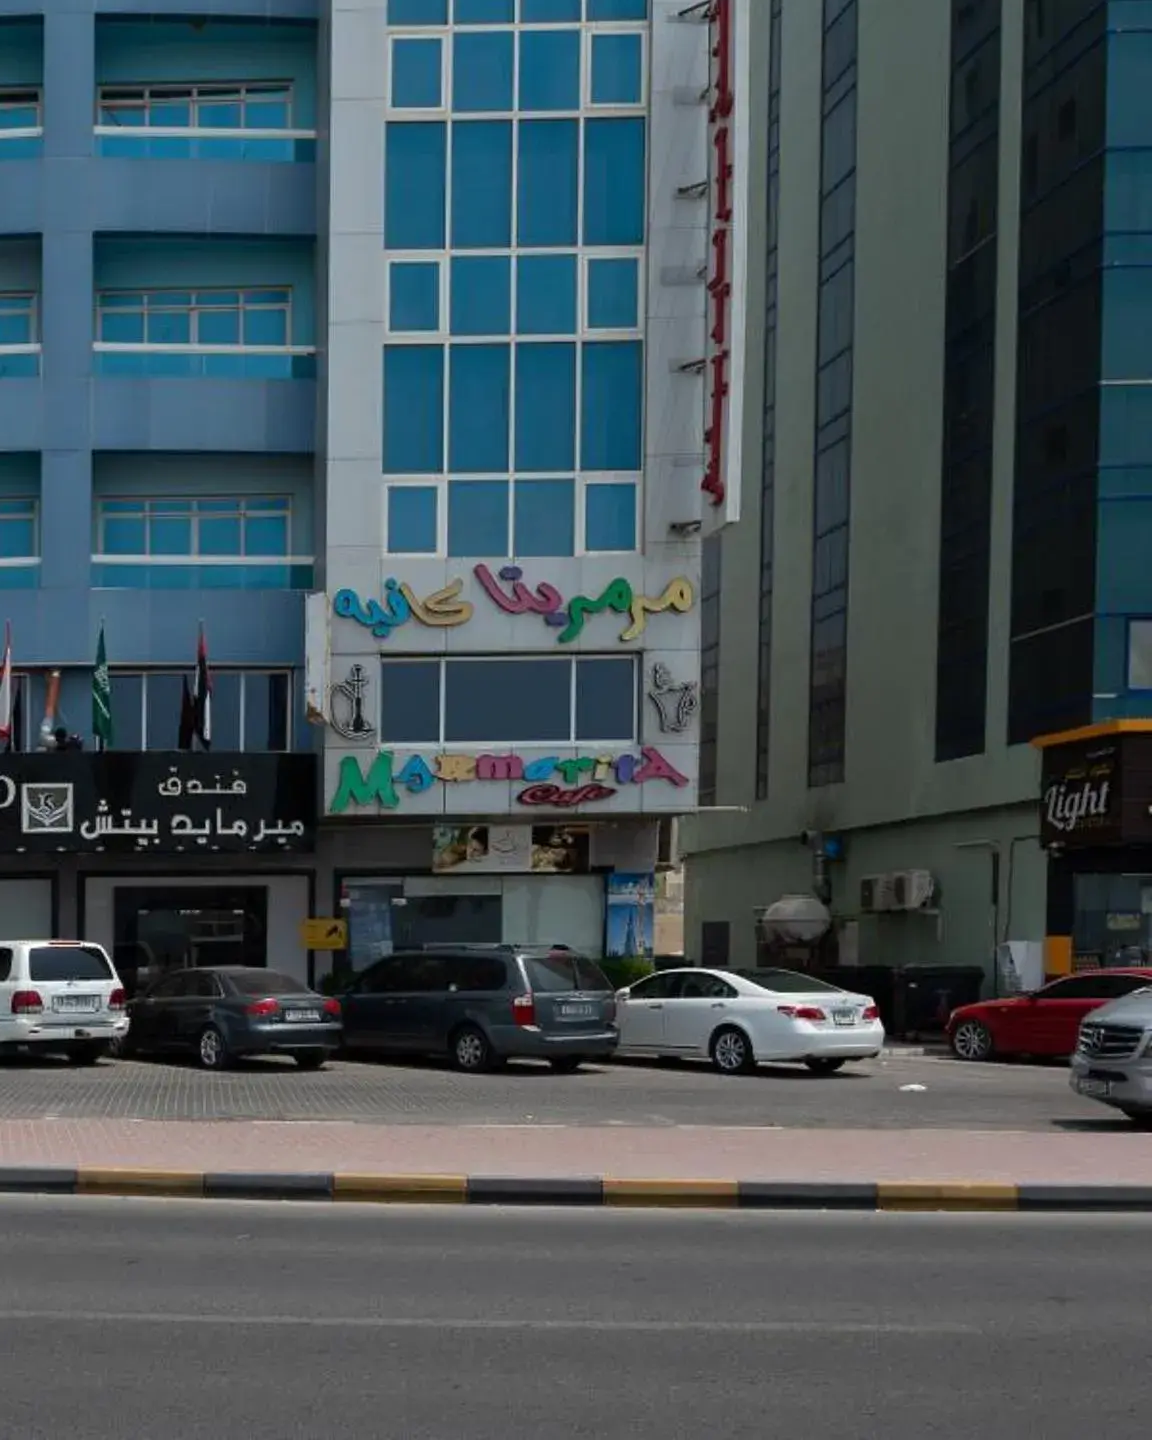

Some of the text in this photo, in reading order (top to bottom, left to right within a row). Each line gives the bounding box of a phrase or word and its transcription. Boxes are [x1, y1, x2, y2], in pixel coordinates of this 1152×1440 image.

[332, 576, 474, 639] كافيه
[157, 766, 248, 797] فندق
[79, 798, 305, 846] ميرمايد بيتش
[1044, 781, 1110, 832] Light
